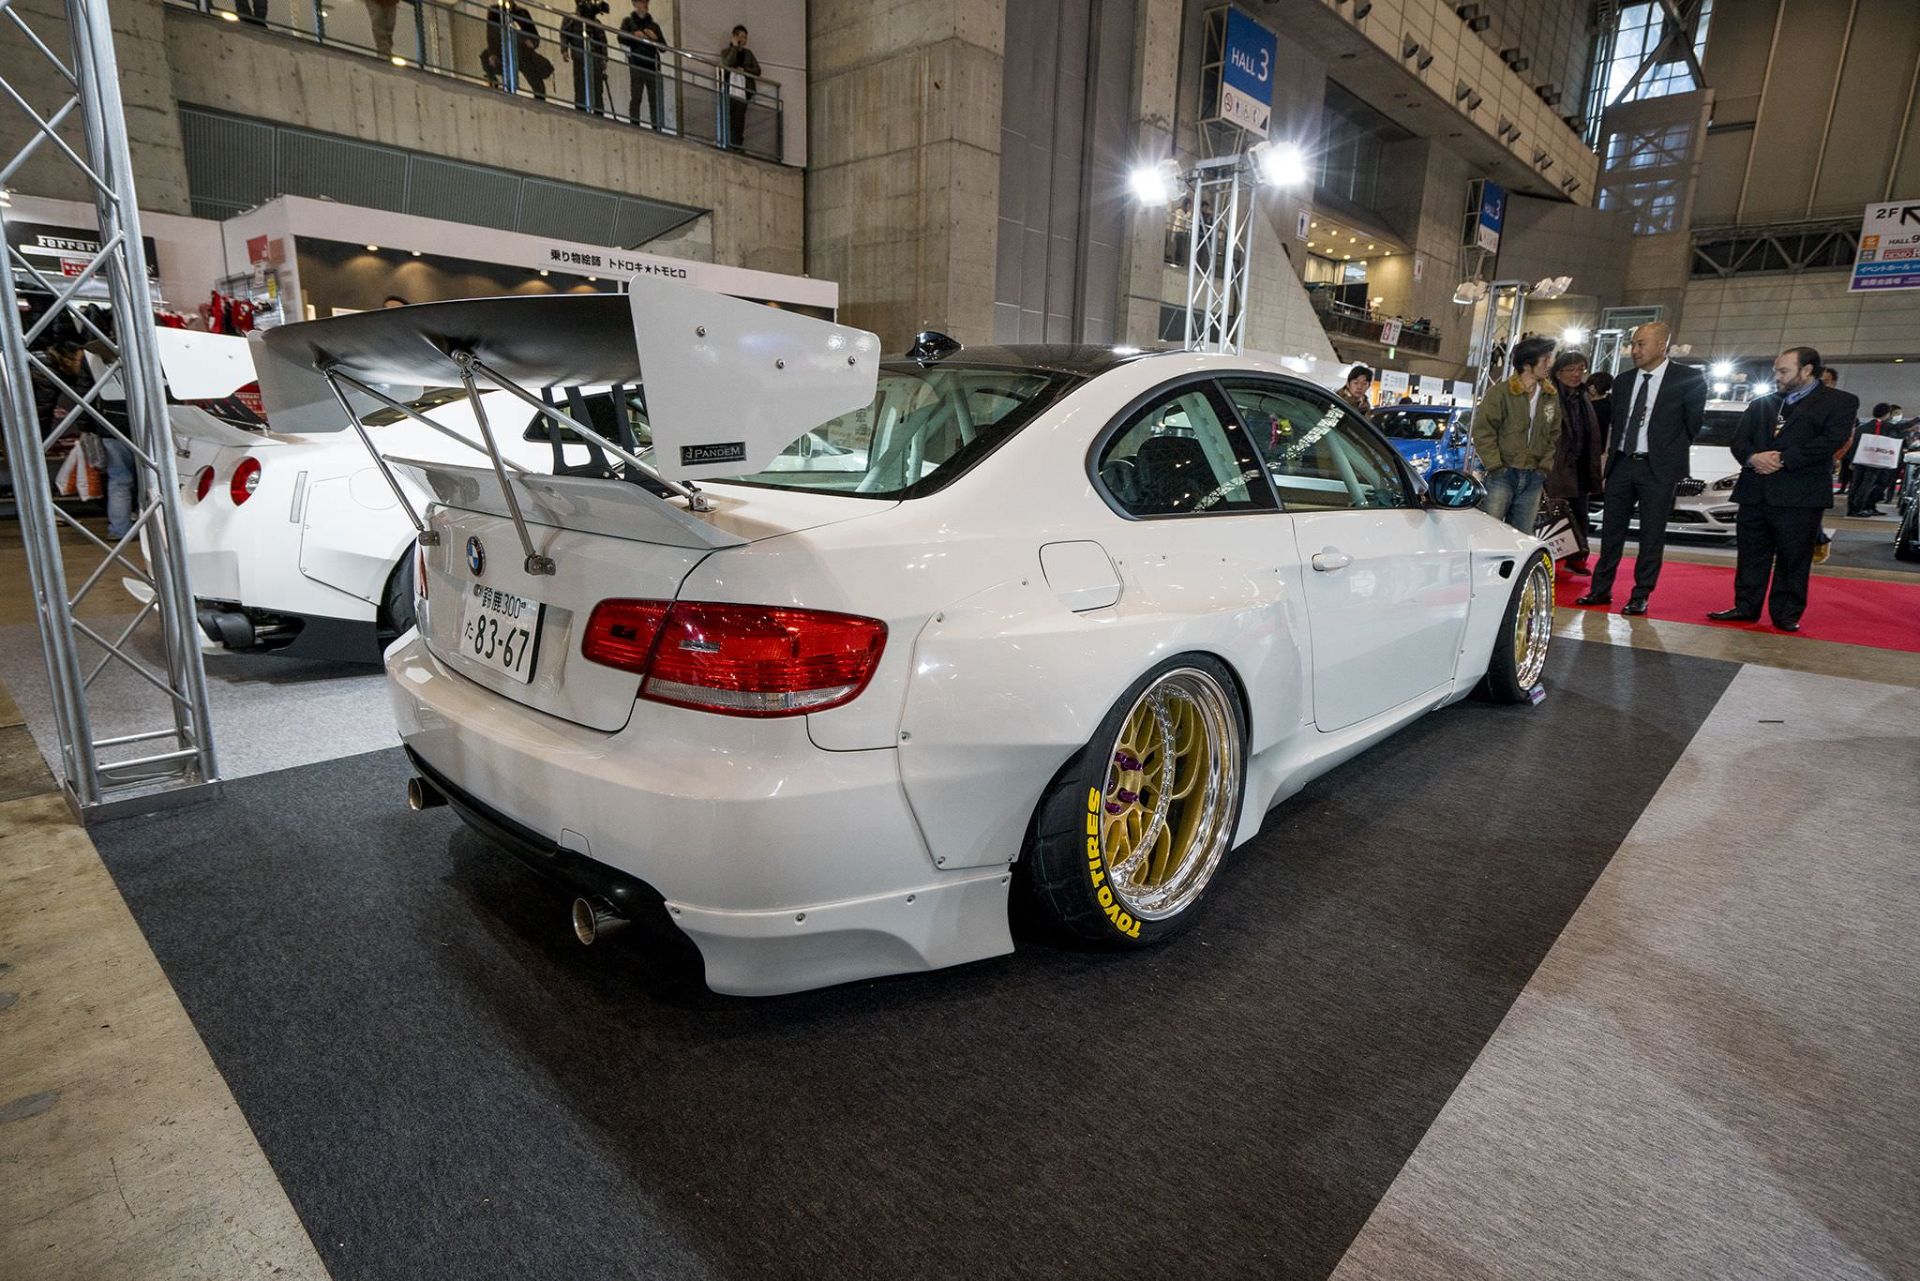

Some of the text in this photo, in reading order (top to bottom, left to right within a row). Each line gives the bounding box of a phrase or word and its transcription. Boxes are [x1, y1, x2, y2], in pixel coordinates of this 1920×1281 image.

[1231, 47, 1269, 81] HALL 3
[1875, 207, 1900, 220] 2F
[36, 234, 101, 252] Ferrari
[550, 249, 601, 267] 乗り物絵師
[694, 446, 741, 458] PANDEM
[464, 614, 530, 672] た 83-67
[1086, 786, 1143, 939] TOYO TIRES
